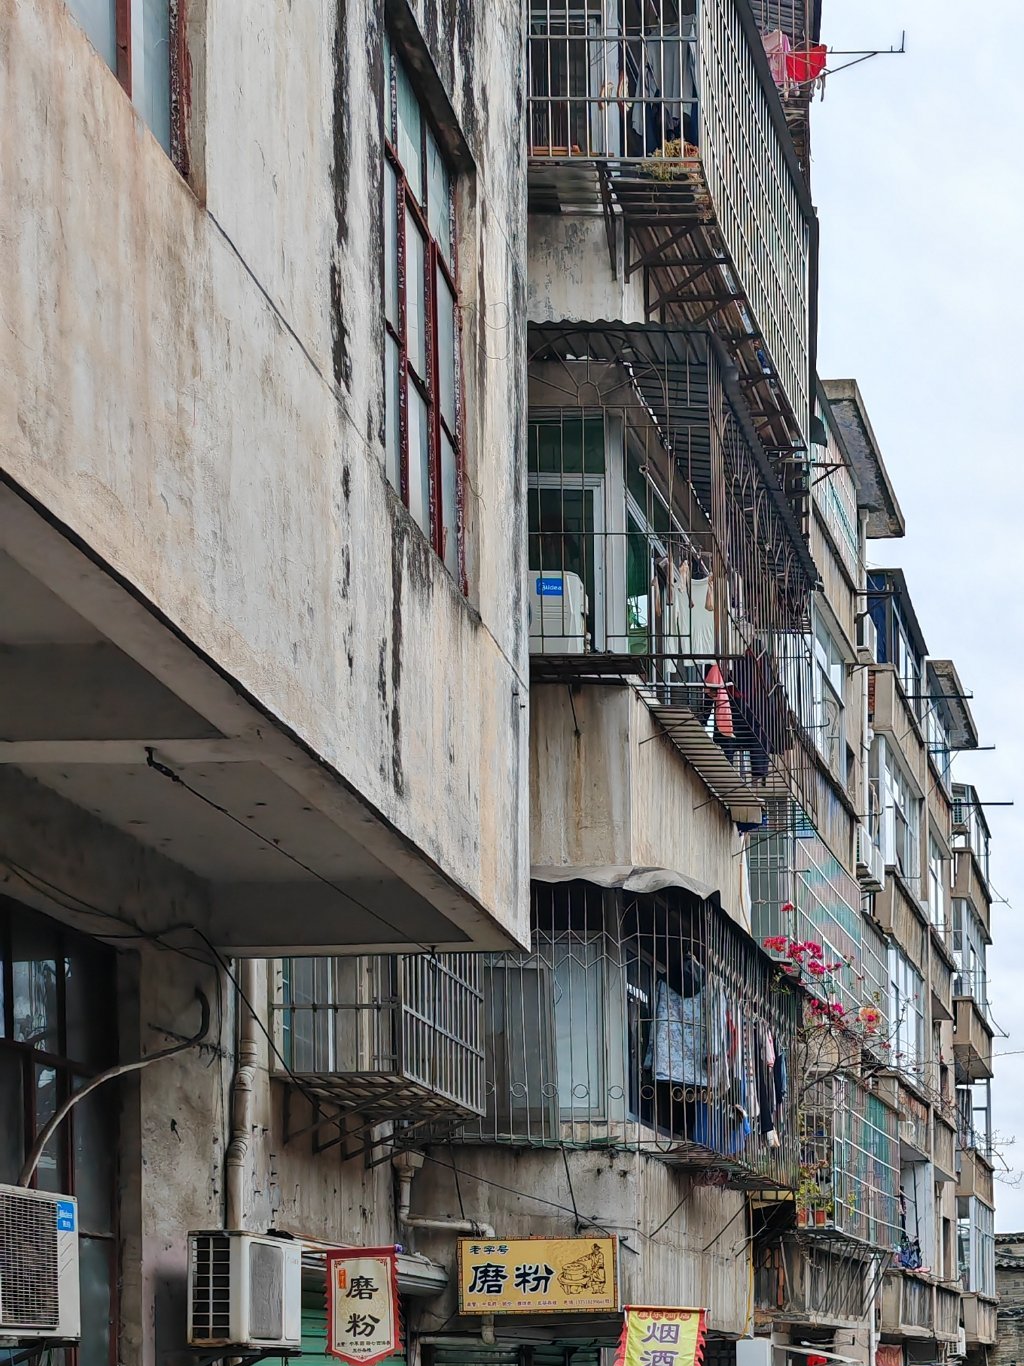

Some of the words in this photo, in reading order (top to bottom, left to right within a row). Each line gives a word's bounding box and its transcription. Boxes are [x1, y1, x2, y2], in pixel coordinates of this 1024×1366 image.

[469, 1245, 509, 1255] 老字号
[468, 1262, 556, 1294] 磨粉
[345, 1275, 381, 1338] 磨粉
